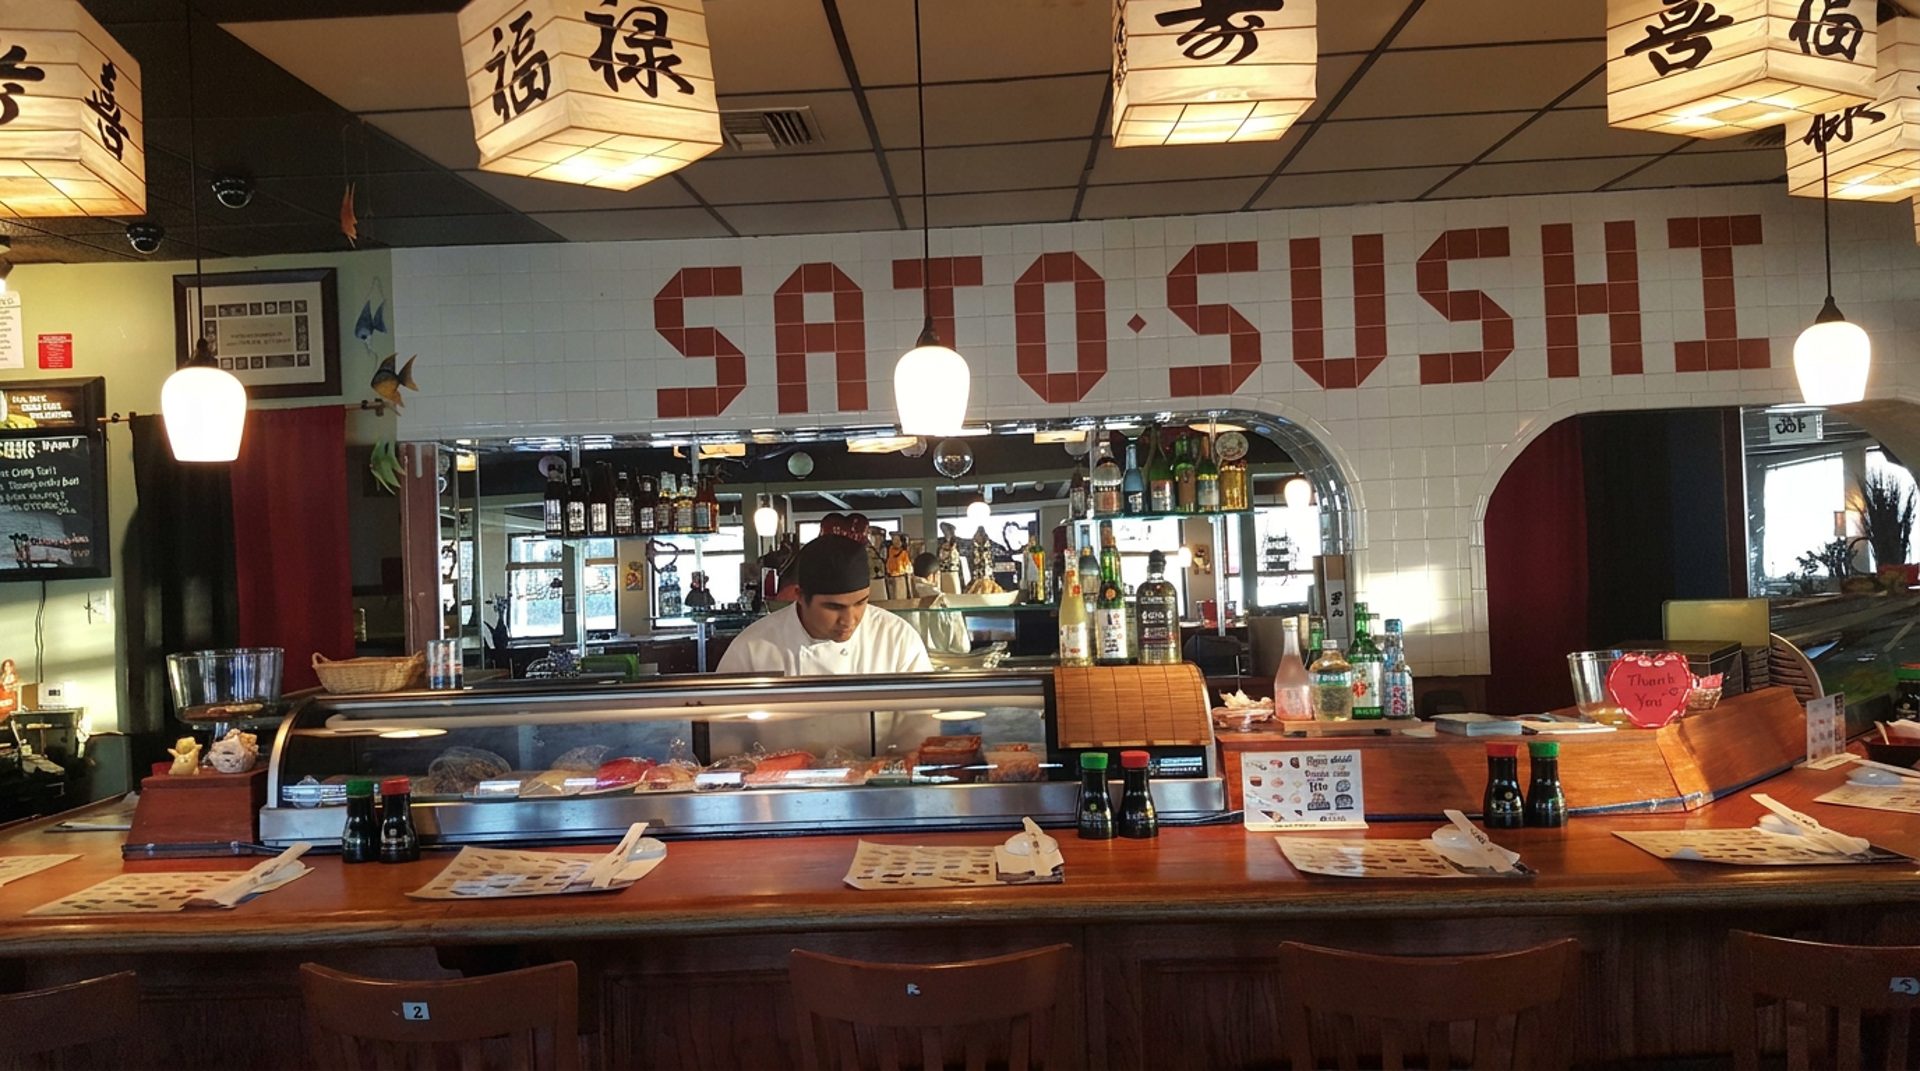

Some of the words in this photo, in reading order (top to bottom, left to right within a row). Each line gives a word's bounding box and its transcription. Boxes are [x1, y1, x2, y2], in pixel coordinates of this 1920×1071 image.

[485, 10, 550, 124] 福
[1166, 213, 1772, 398] SUSHI
[1626, 672, 1677, 688] Thank
[1635, 692, 1663, 711] You
[412, 1005, 424, 1019] 2
